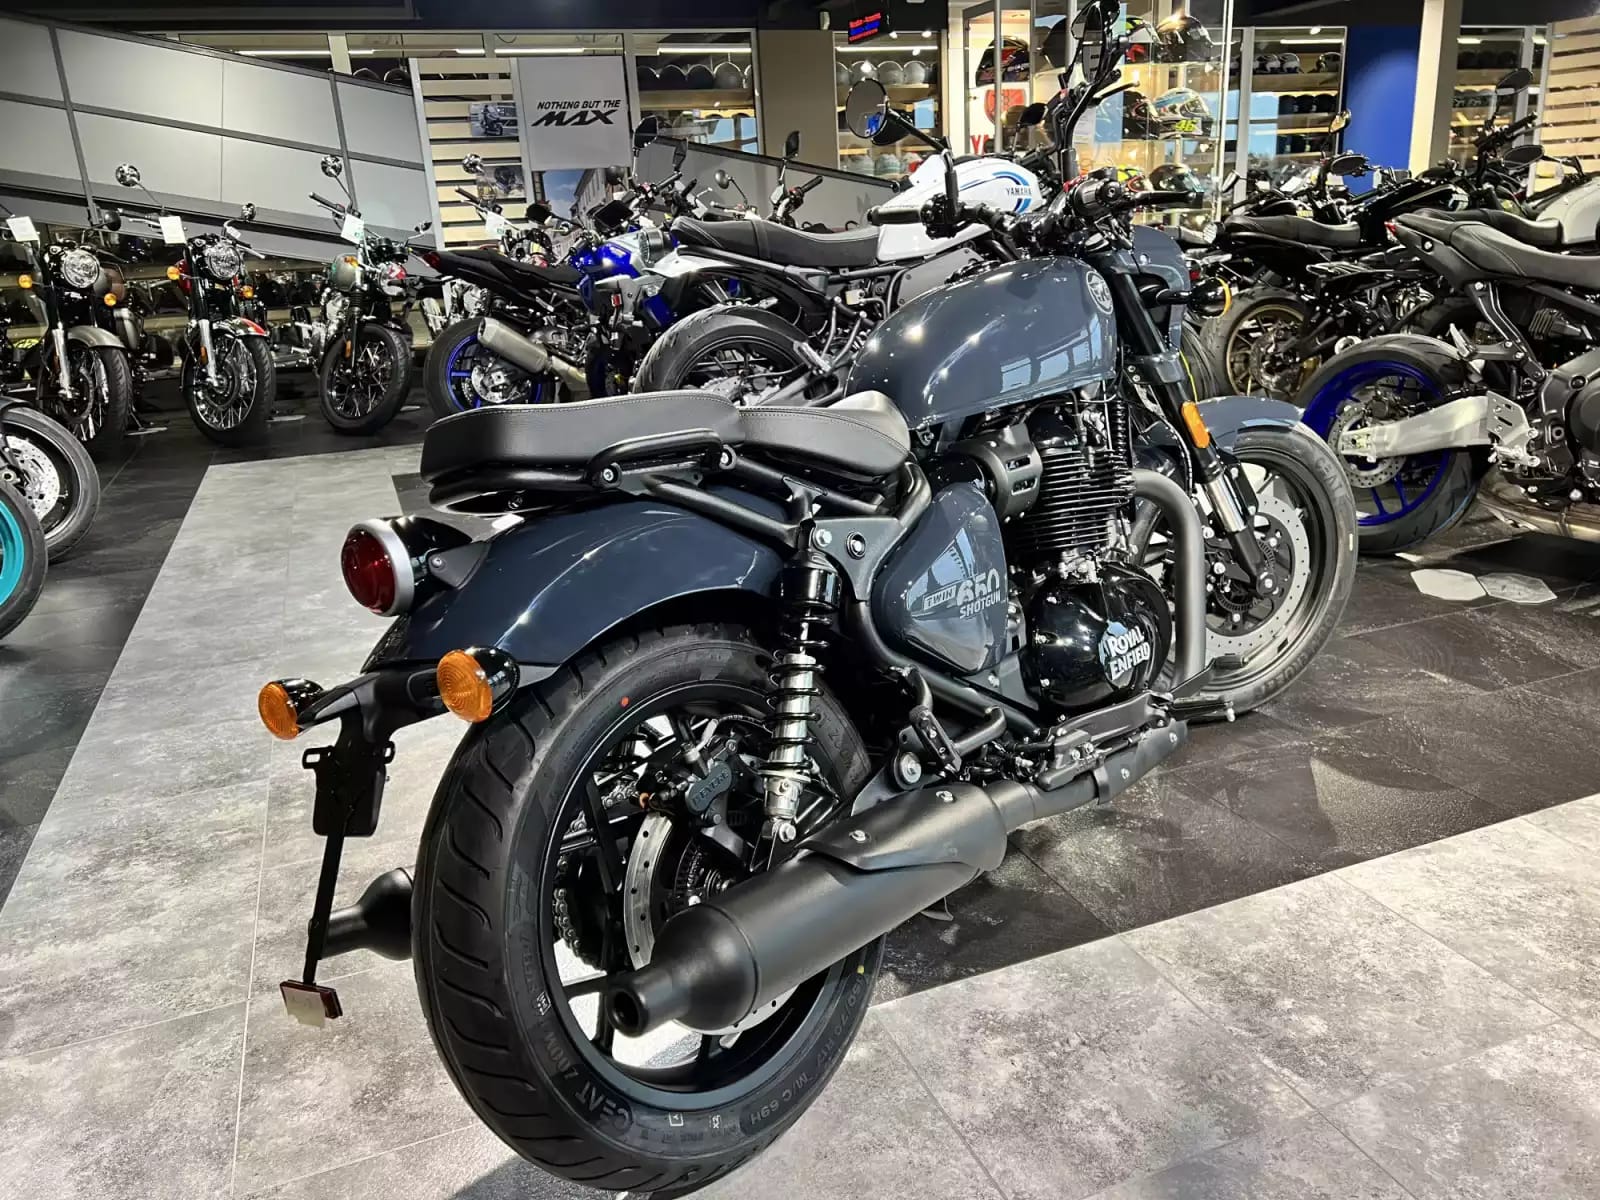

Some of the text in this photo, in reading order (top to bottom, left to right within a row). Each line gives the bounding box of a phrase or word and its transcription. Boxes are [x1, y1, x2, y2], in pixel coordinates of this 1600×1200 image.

[537, 99, 621, 109] NOTHING BUT THE
[531, 109, 618, 127] MAX
[1175, 119, 1197, 132] 46
[1006, 187, 1032, 196] YAMAHA
[925, 585, 957, 609] TWIN
[957, 568, 1000, 606] 650
[960, 590, 1001, 619] SHOTGUN
[1107, 626, 1145, 657] ROYAL
[1108, 642, 1150, 681] ENFIELD
[750, 1100, 780, 1126] 69H
